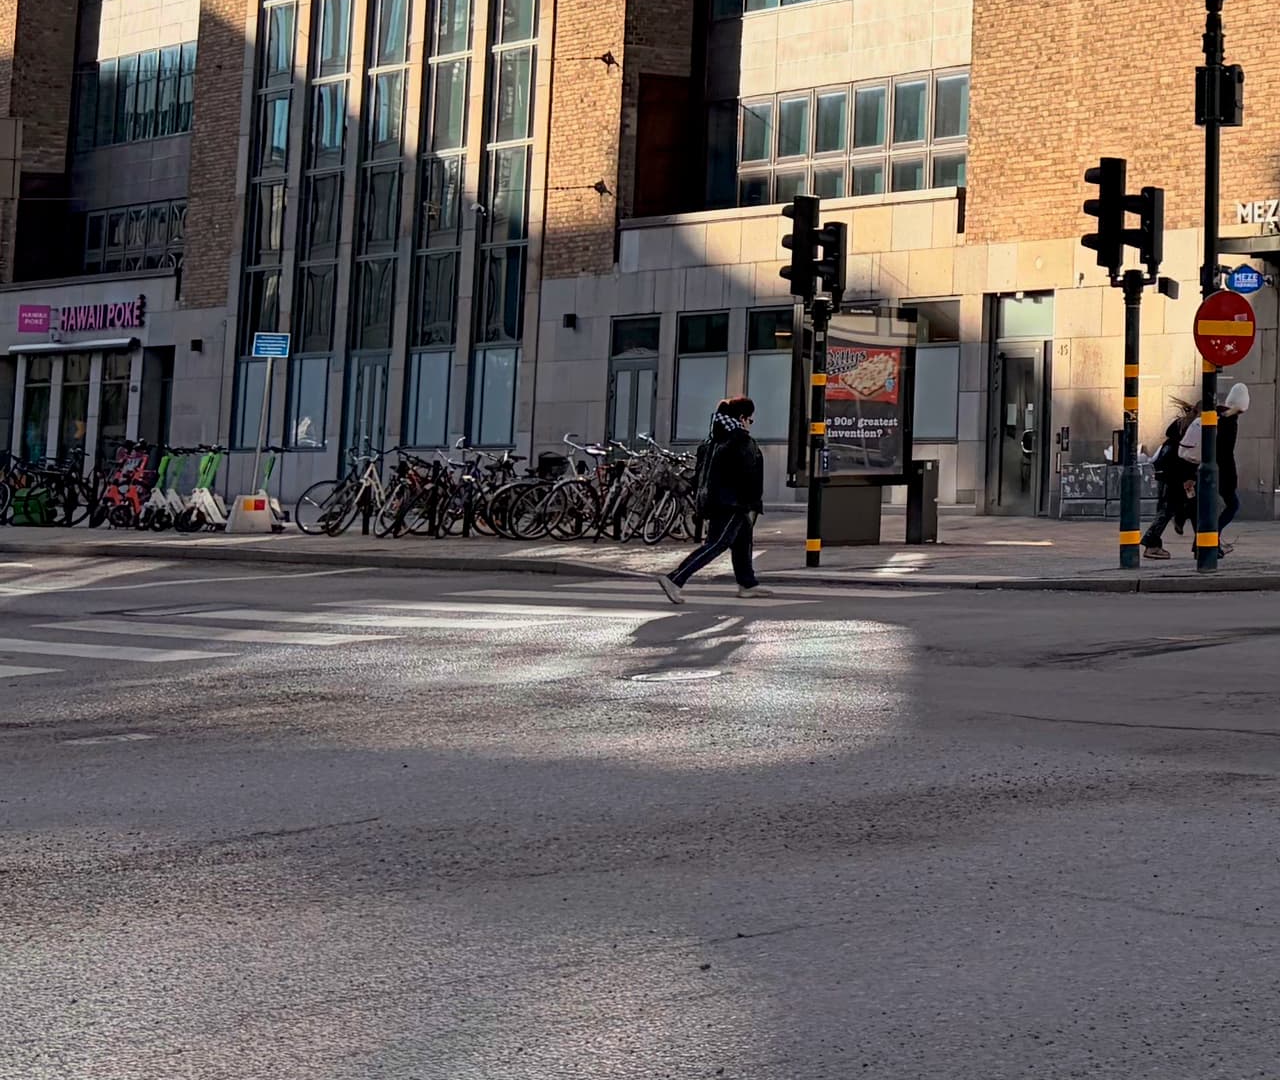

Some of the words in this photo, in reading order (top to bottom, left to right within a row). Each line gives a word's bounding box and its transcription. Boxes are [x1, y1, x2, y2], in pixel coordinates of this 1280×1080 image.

[1234, 272, 1259, 281] MEZE
[61, 304, 104, 331] HAWAII
[857, 416, 899, 428] greatest
[827, 428, 884, 438] invention?
